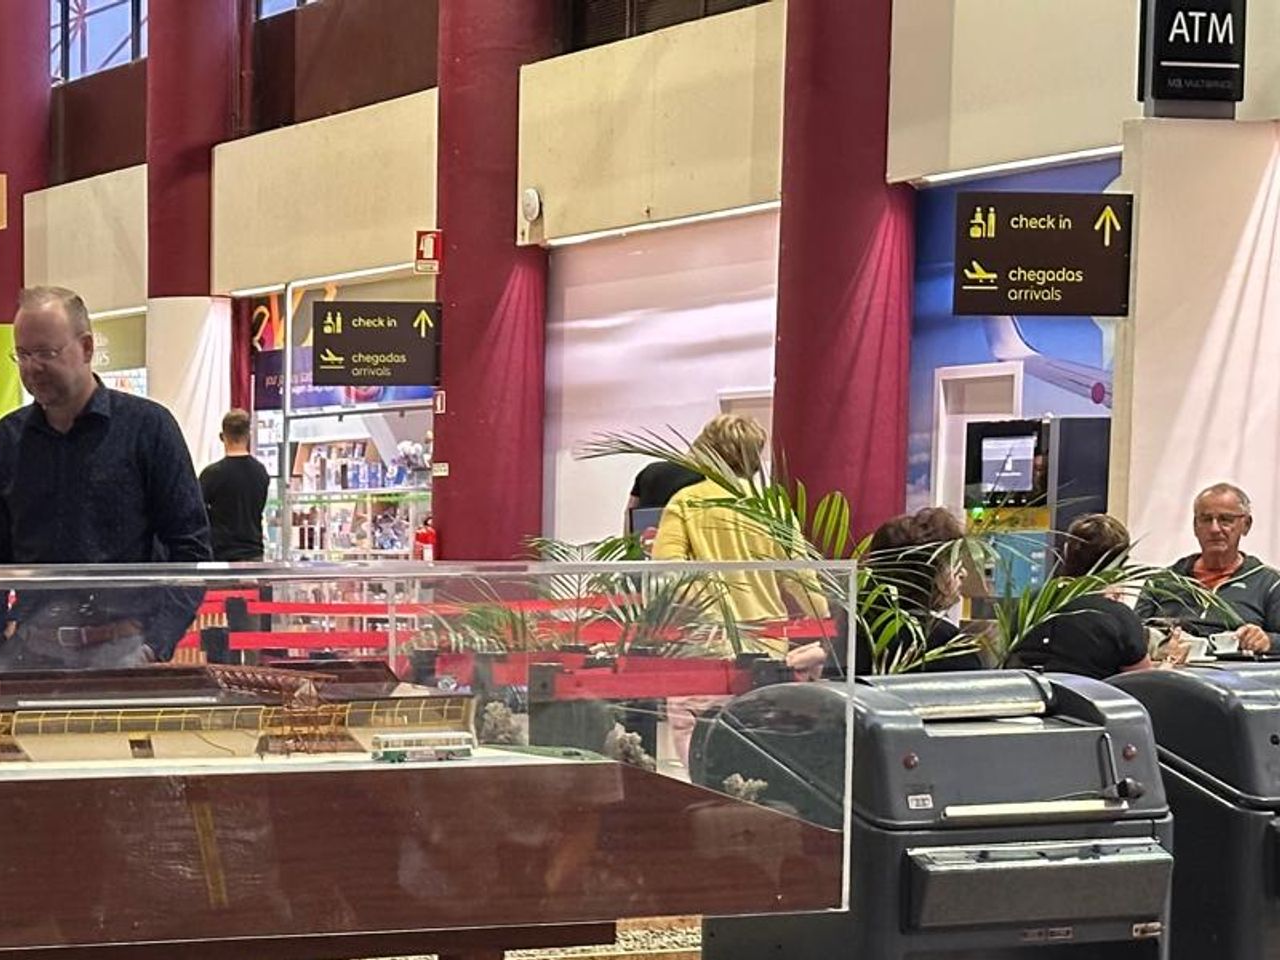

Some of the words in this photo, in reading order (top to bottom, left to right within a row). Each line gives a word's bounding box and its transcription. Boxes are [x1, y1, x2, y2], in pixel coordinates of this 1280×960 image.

[1168, 11, 1234, 44] ATM
[1009, 214, 1056, 230] check
[1058, 214, 1072, 230] in
[1007, 267, 1084, 285] chegadas
[1007, 286, 1063, 301] arrivals
[351, 316, 385, 328] check
[387, 316, 398, 328] in
[351, 352, 407, 366] chegadas
[351, 366, 392, 376] arrivals
